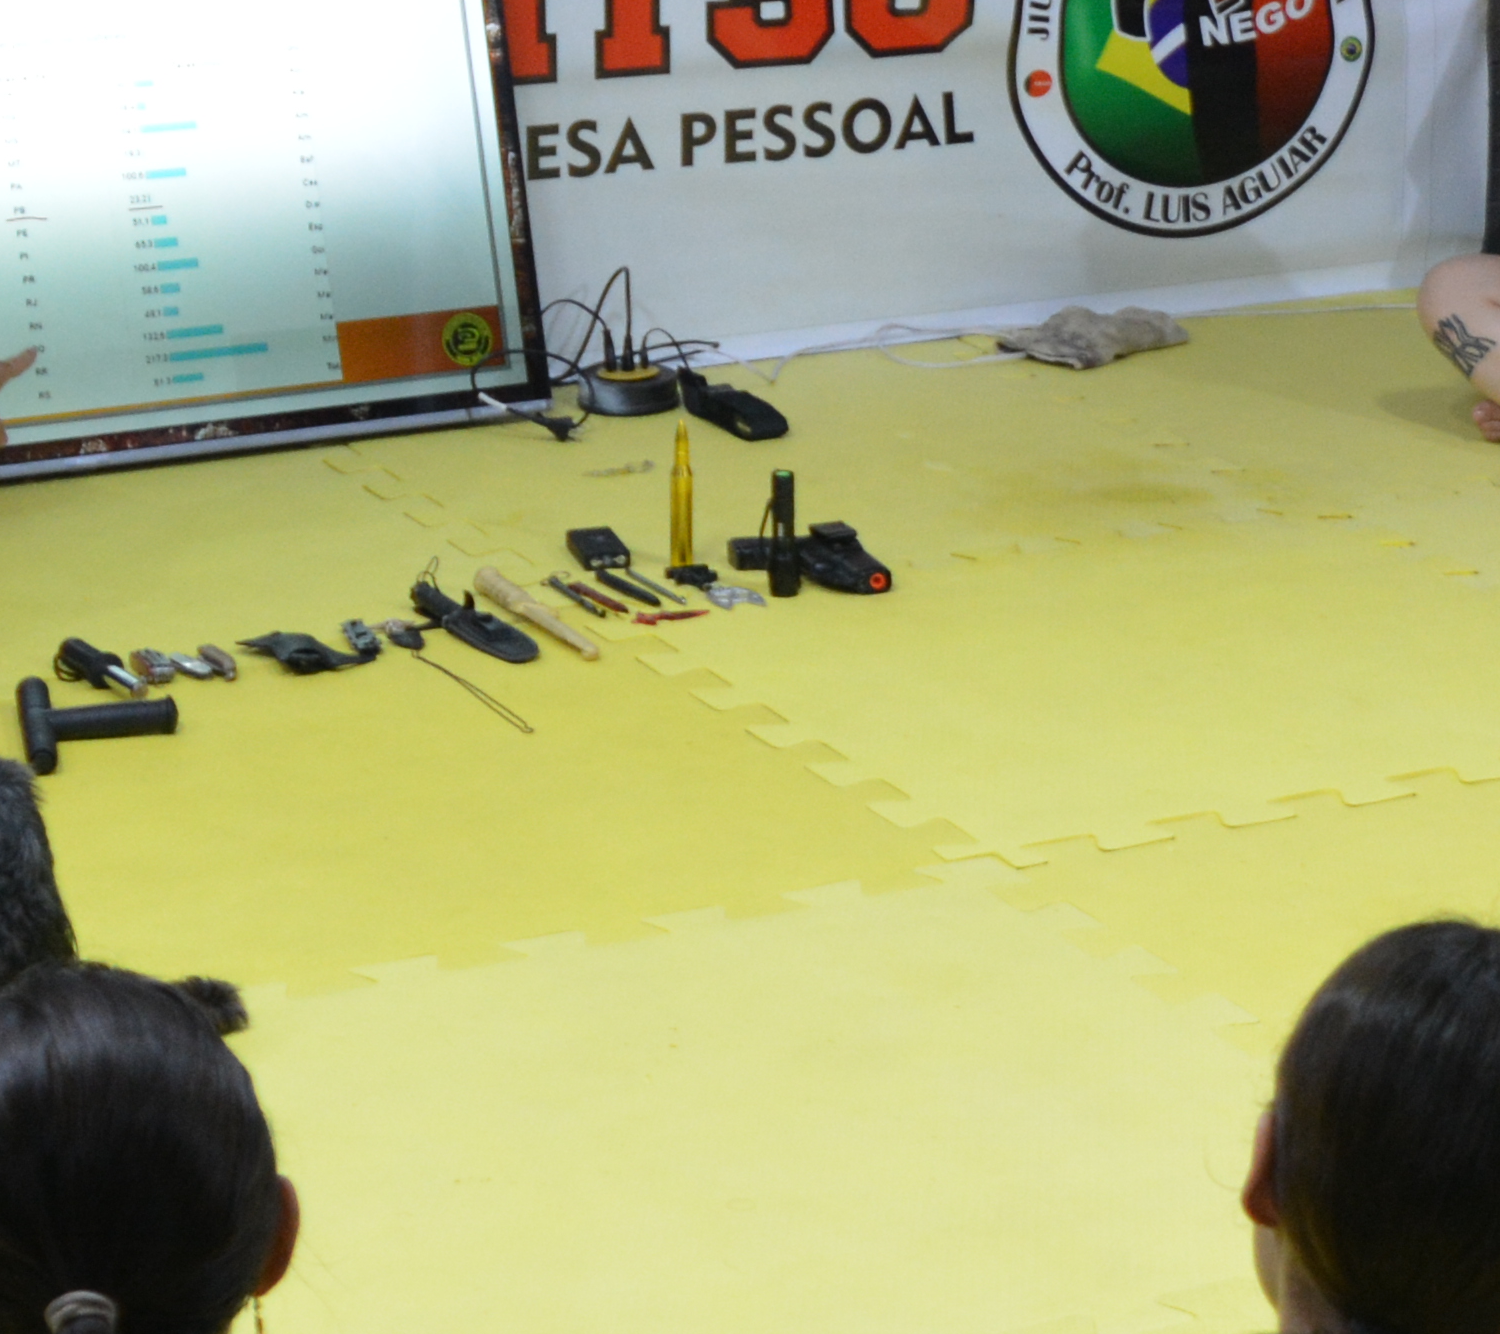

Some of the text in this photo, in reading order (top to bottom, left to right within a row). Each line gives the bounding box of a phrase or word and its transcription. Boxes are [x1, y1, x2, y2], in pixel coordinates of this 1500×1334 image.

[679, 91, 976, 170] PESSOAL
[1064, 125, 1328, 225] Prof. LUIS AGUIAR
